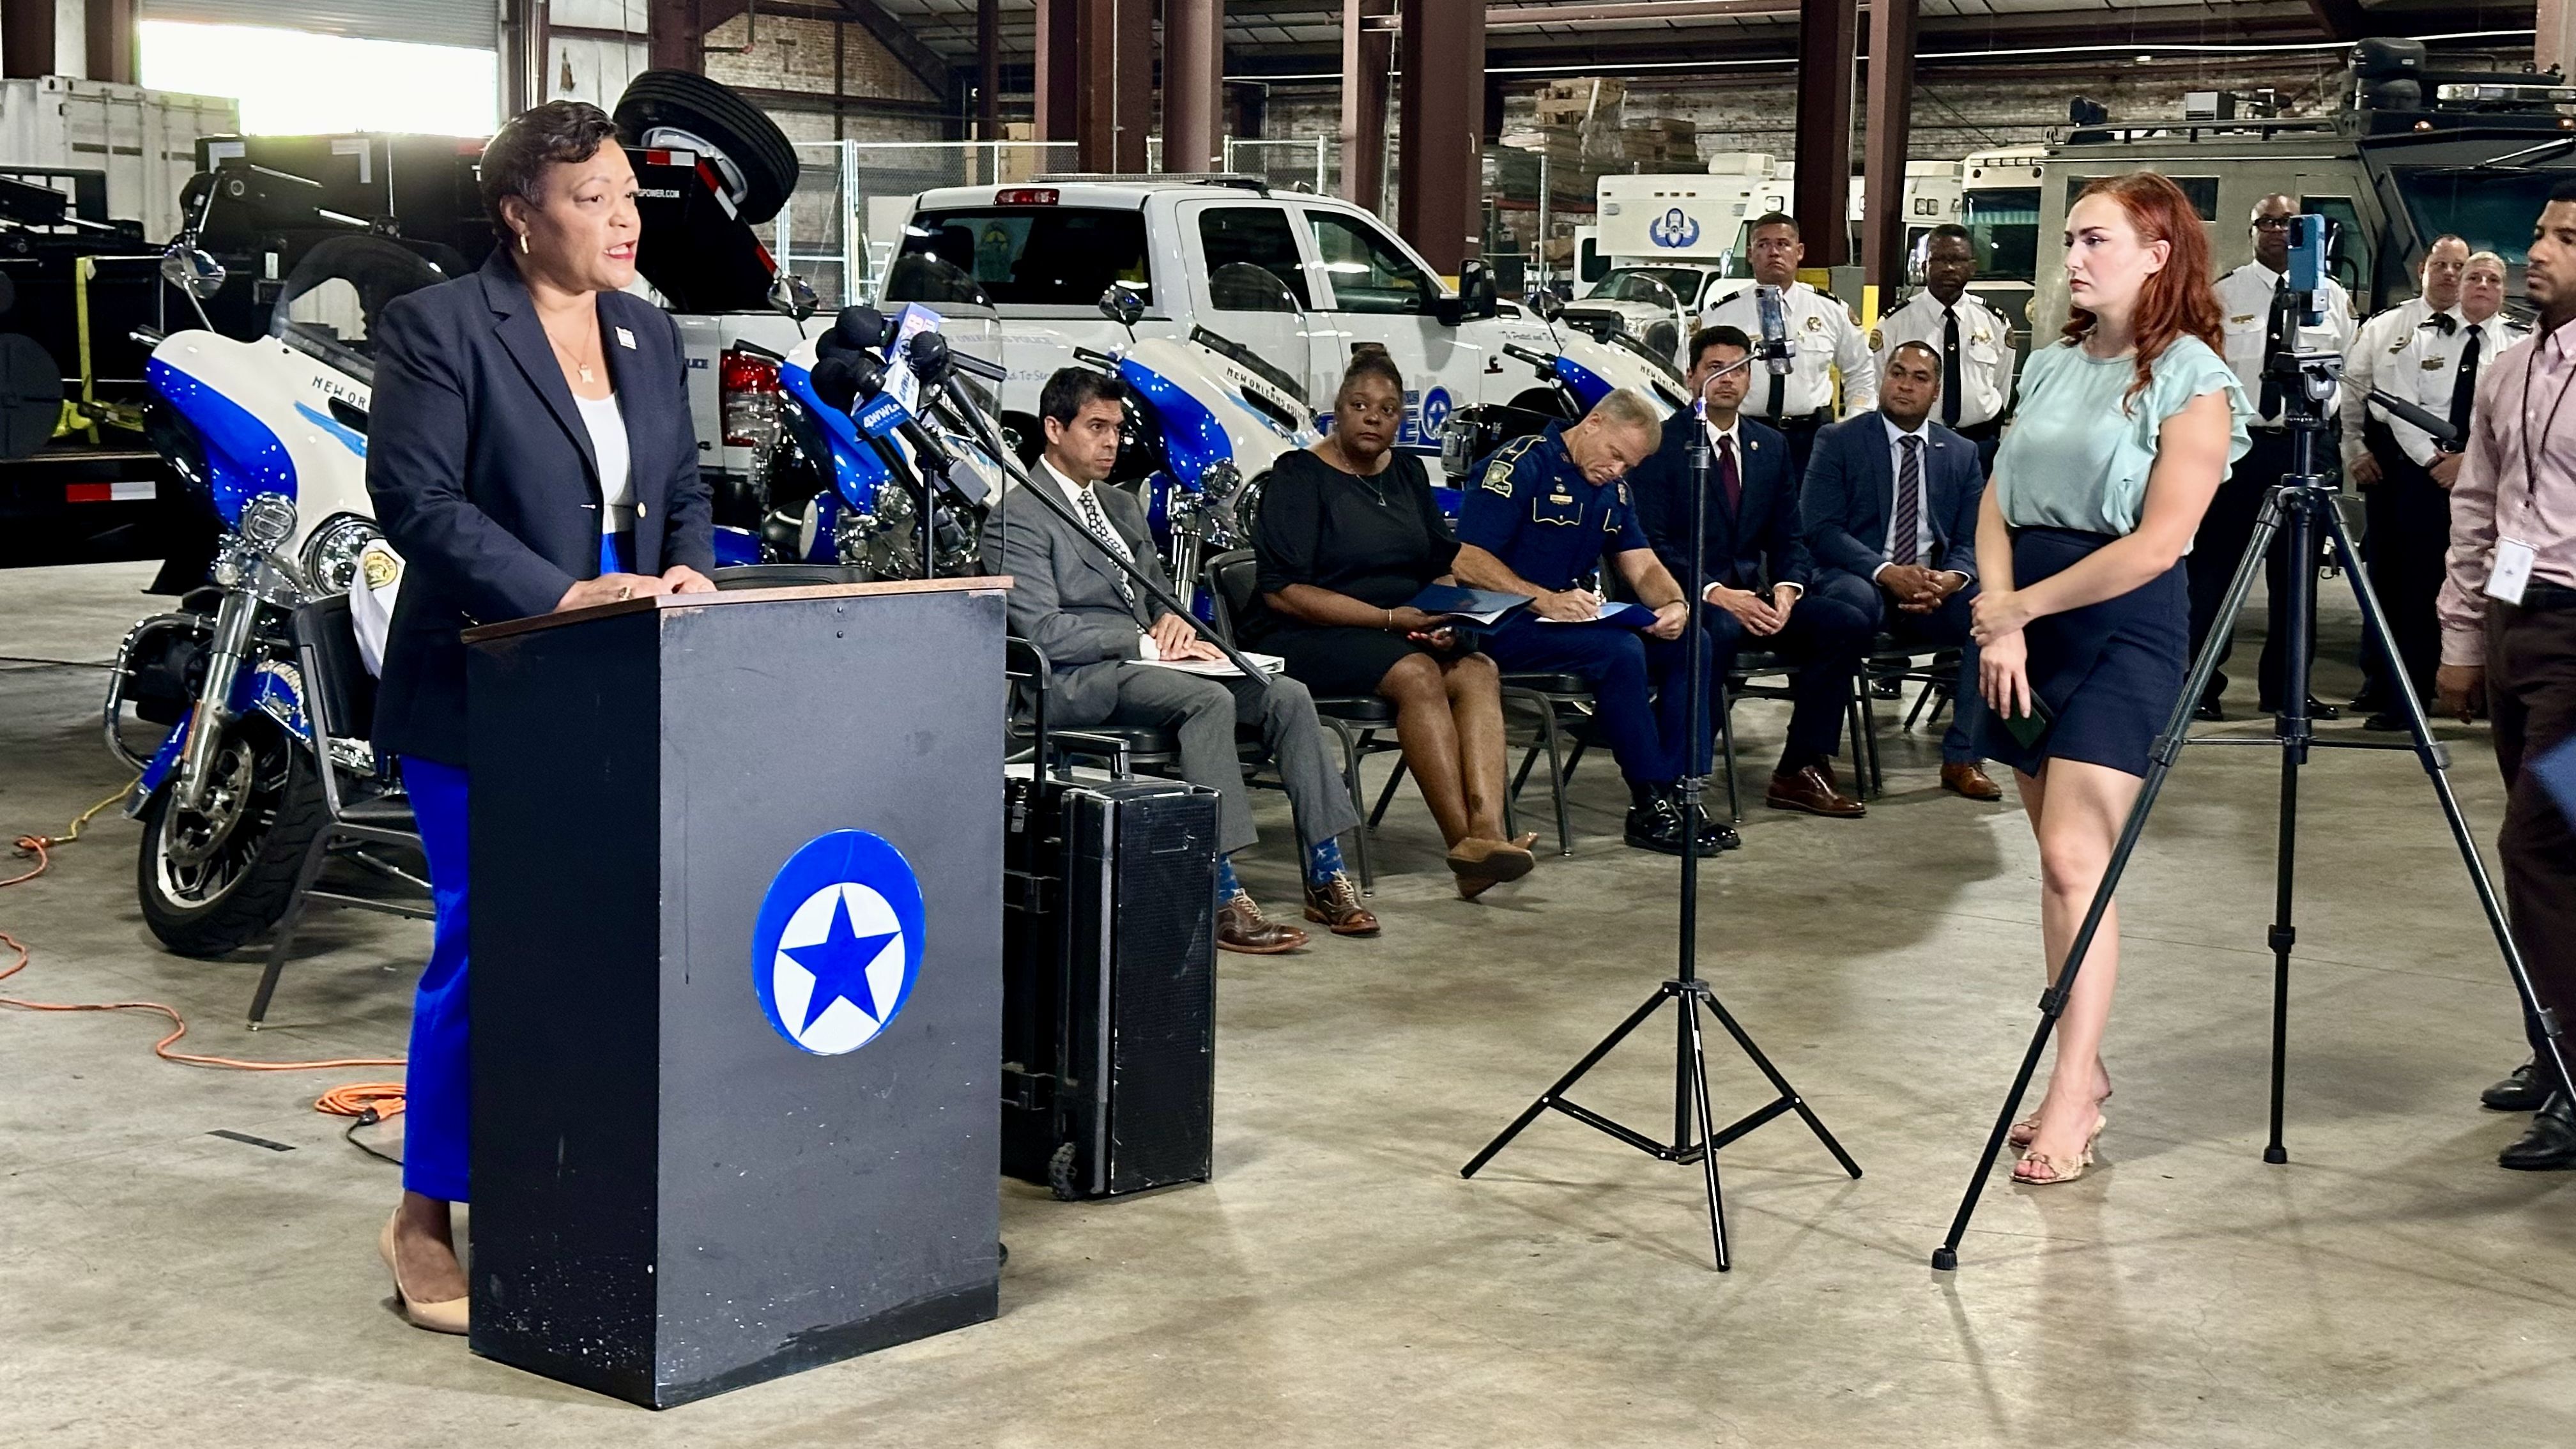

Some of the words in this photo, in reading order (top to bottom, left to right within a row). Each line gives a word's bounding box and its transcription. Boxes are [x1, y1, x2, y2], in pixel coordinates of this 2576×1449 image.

[1640, 364, 1656, 379] NEW
[312, 376, 344, 396] NEW
[1227, 367, 1246, 383] NEW
[1249, 378, 1285, 408] ORLEANS
